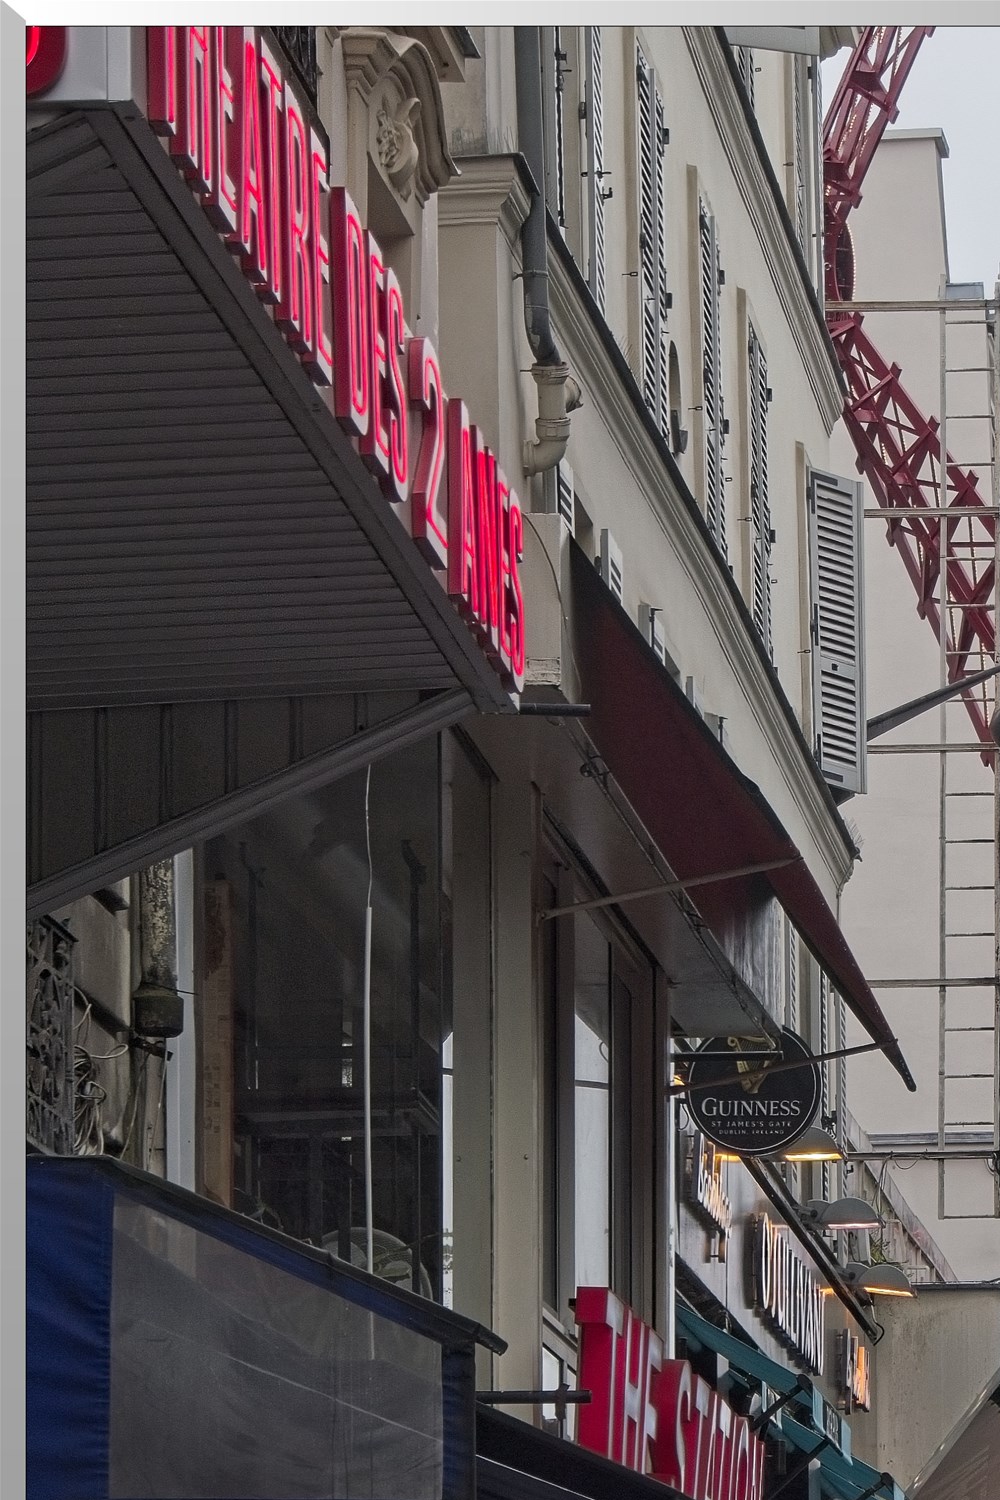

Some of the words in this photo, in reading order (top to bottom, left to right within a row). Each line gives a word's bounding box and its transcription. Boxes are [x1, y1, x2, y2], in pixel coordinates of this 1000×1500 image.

[331, 187, 407, 502] DES
[408, 337, 448, 571] 2
[449, 399, 524, 694] ANES
[701, 1097, 801, 1116] GUINNESS
[576, 1287, 665, 1476] THE
